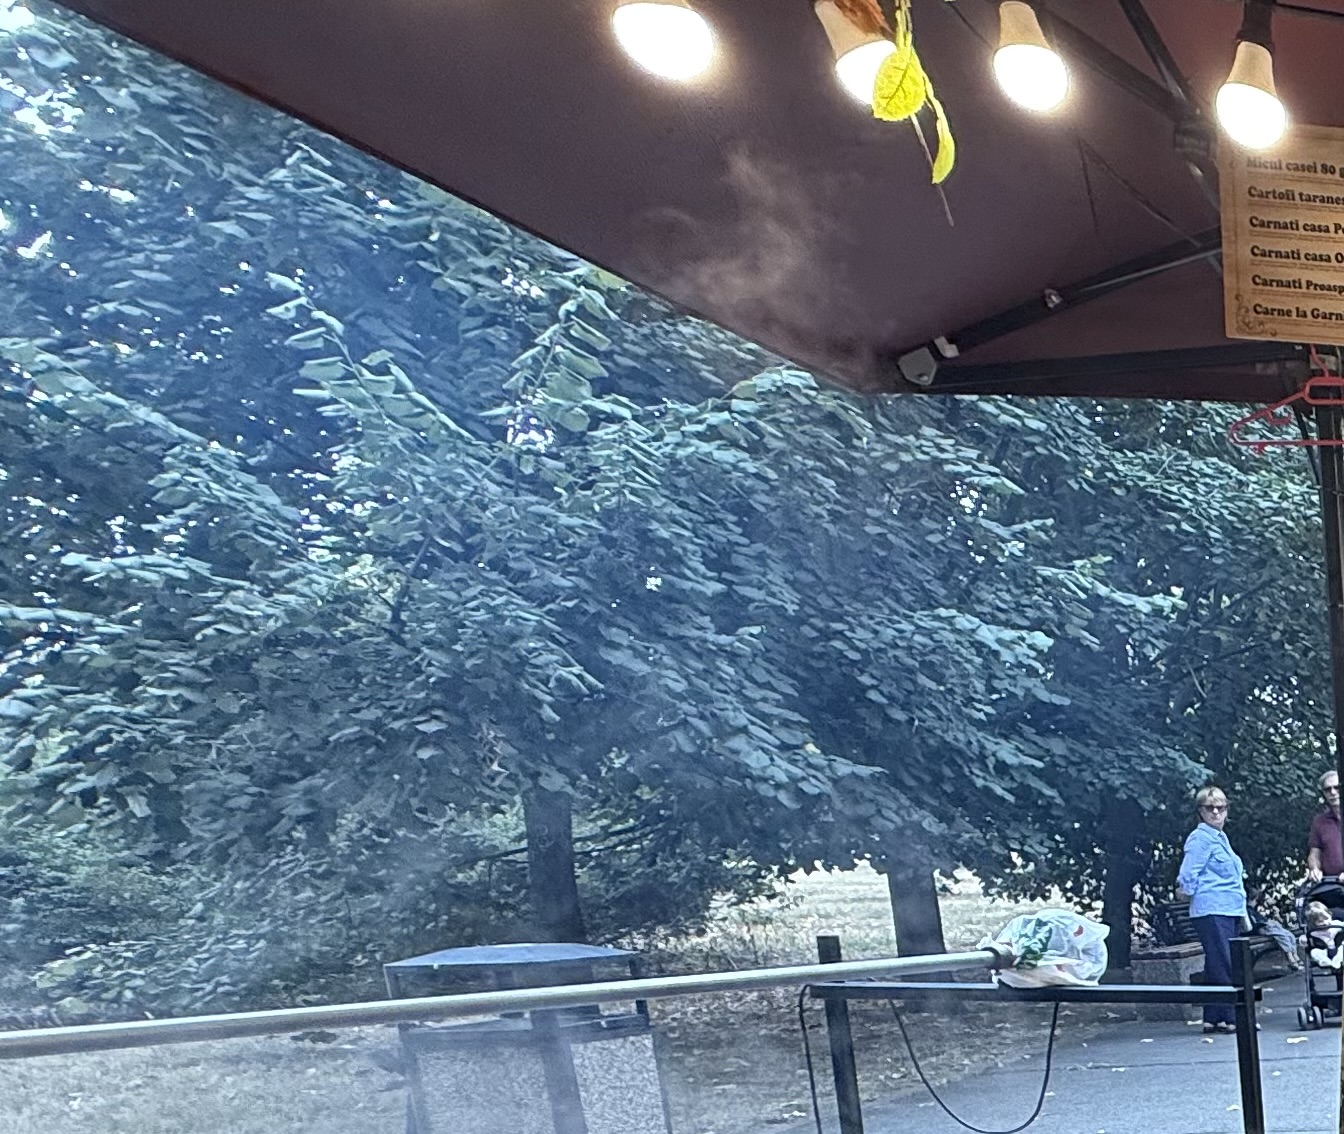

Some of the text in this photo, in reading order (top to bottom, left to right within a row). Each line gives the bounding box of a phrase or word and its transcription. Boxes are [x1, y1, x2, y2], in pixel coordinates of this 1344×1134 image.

[1286, 161, 1317, 174] casei
[1320, 162, 1336, 175] 80
[1247, 185, 1296, 199] Cartofi
[1249, 215, 1300, 232] Carnati
[1303, 221, 1331, 234] casa
[1250, 245, 1301, 260] Carnati
[1304, 251, 1332, 264] casa
[1252, 274, 1302, 290] Carnati
[1253, 303, 1293, 318] Carne
[1296, 306, 1308, 319] la
